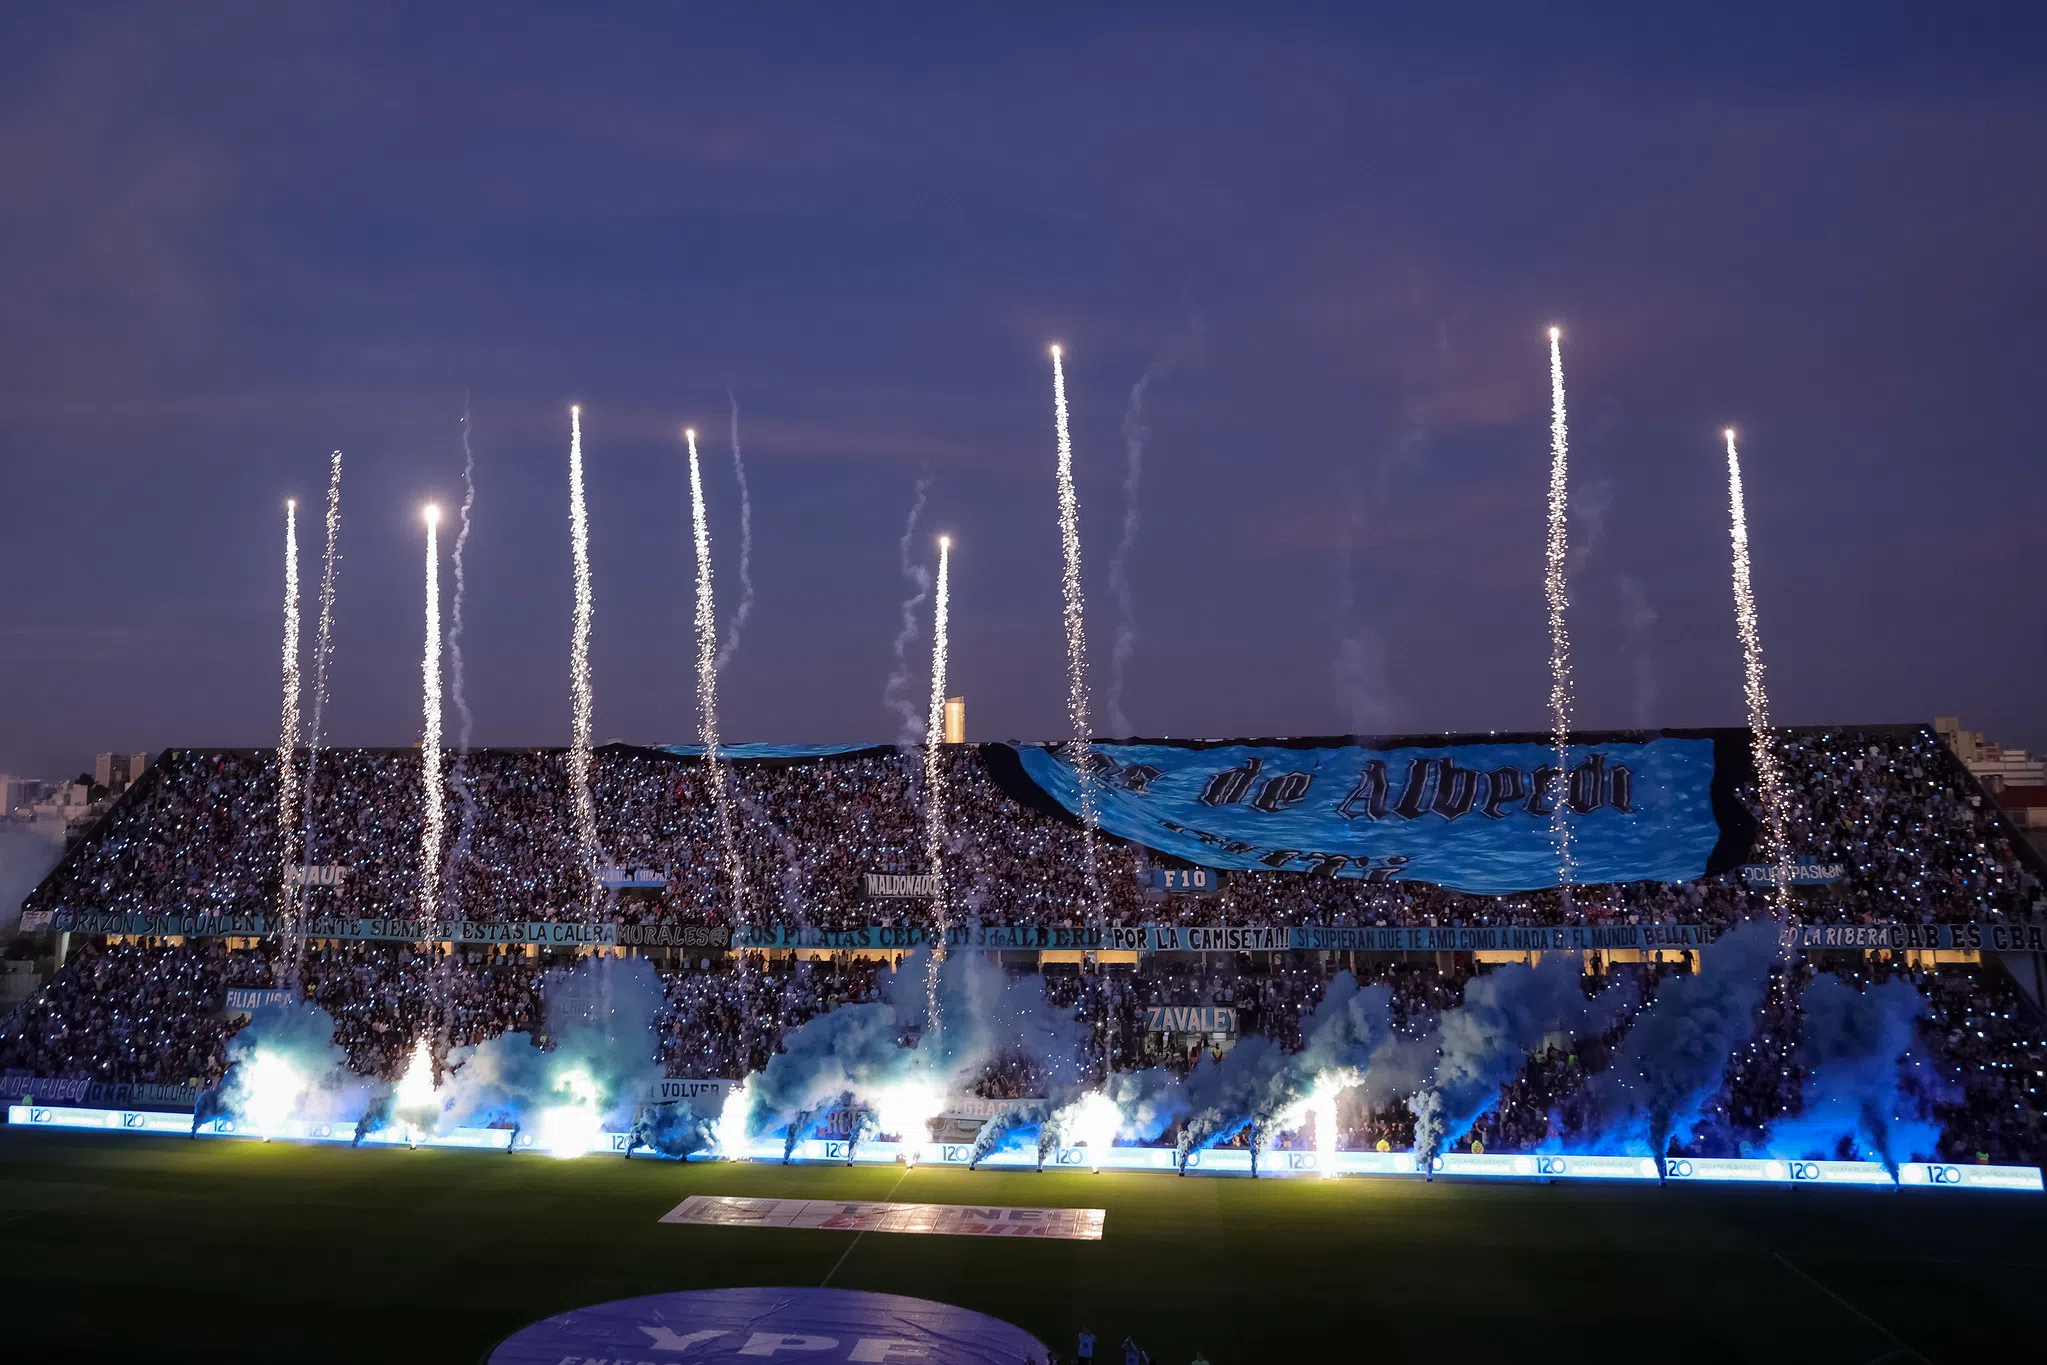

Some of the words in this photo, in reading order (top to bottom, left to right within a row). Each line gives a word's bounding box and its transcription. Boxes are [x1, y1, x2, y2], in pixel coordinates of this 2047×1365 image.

[1335, 752, 1637, 822] Alberdi
[867, 874, 939, 896] MALDONADO
[231, 915, 255, 932] EN
[370, 920, 453, 938] SIEMPE
[462, 921, 526, 941] ESTAS
[528, 924, 547, 941] LA
[553, 925, 615, 943] CALERA
[617, 925, 709, 947] MURALES
[1644, 925, 1690, 945] BELLA
[1826, 927, 1888, 946] RIBERA
[1112, 927, 1148, 950] POR
[1154, 927, 1180, 949] LA
[1188, 927, 1290, 950] CAMISETA!!!
[1297, 929, 1309, 948] SI
[1313, 929, 1375, 949] SUPIERAN
[1378, 930, 1401, 948] QUE
[1406, 929, 1421, 948] TE
[1428, 929, 1456, 948] AMO
[1460, 929, 1495, 949] COMO
[1501, 929, 1509, 948] A
[1513, 929, 1548, 949] NADA
[1591, 927, 1638, 948] MUNDO
[1889, 925, 1940, 949] CAB
[1949, 925, 1982, 949] ES
[1992, 925, 2045, 950] CBA
[30, 1108, 52, 1123] 120
[124, 1113, 145, 1127] 120
[214, 1117, 236, 1132] 120
[943, 1145, 970, 1161] 120
[1056, 1149, 1083, 1164] 120
[1172, 1150, 1199, 1167] 10
[1288, 1153, 1316, 1169] 120
[1536, 1157, 1566, 1174] 120
[1664, 1159, 1693, 1177] 120
[1788, 1162, 1820, 1180] 120
[1927, 1166, 1961, 1184] 120
[639, 1326, 938, 1363] YPF
